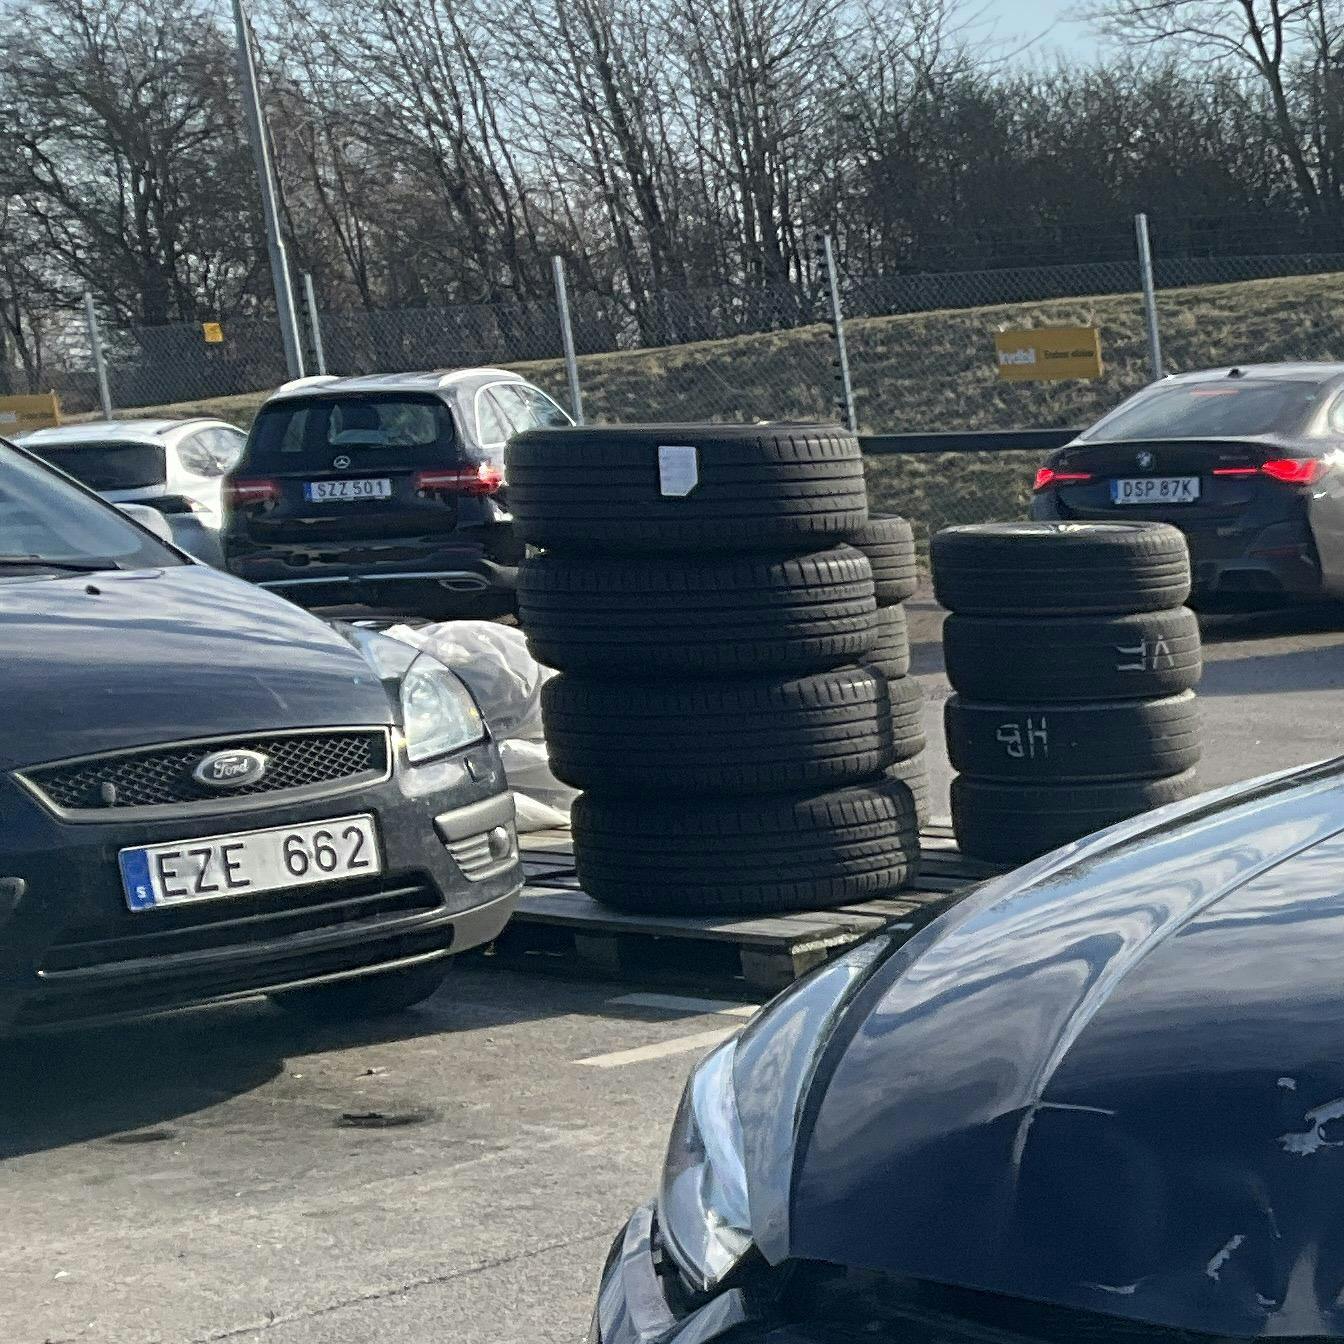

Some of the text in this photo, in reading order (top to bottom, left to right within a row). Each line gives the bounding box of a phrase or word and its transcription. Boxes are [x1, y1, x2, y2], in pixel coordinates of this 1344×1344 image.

[317, 479, 384, 497] SZZ 501
[1123, 479, 1192, 497] DSP 87K
[212, 756, 250, 779] Ford
[156, 825, 370, 898] EZE 662
